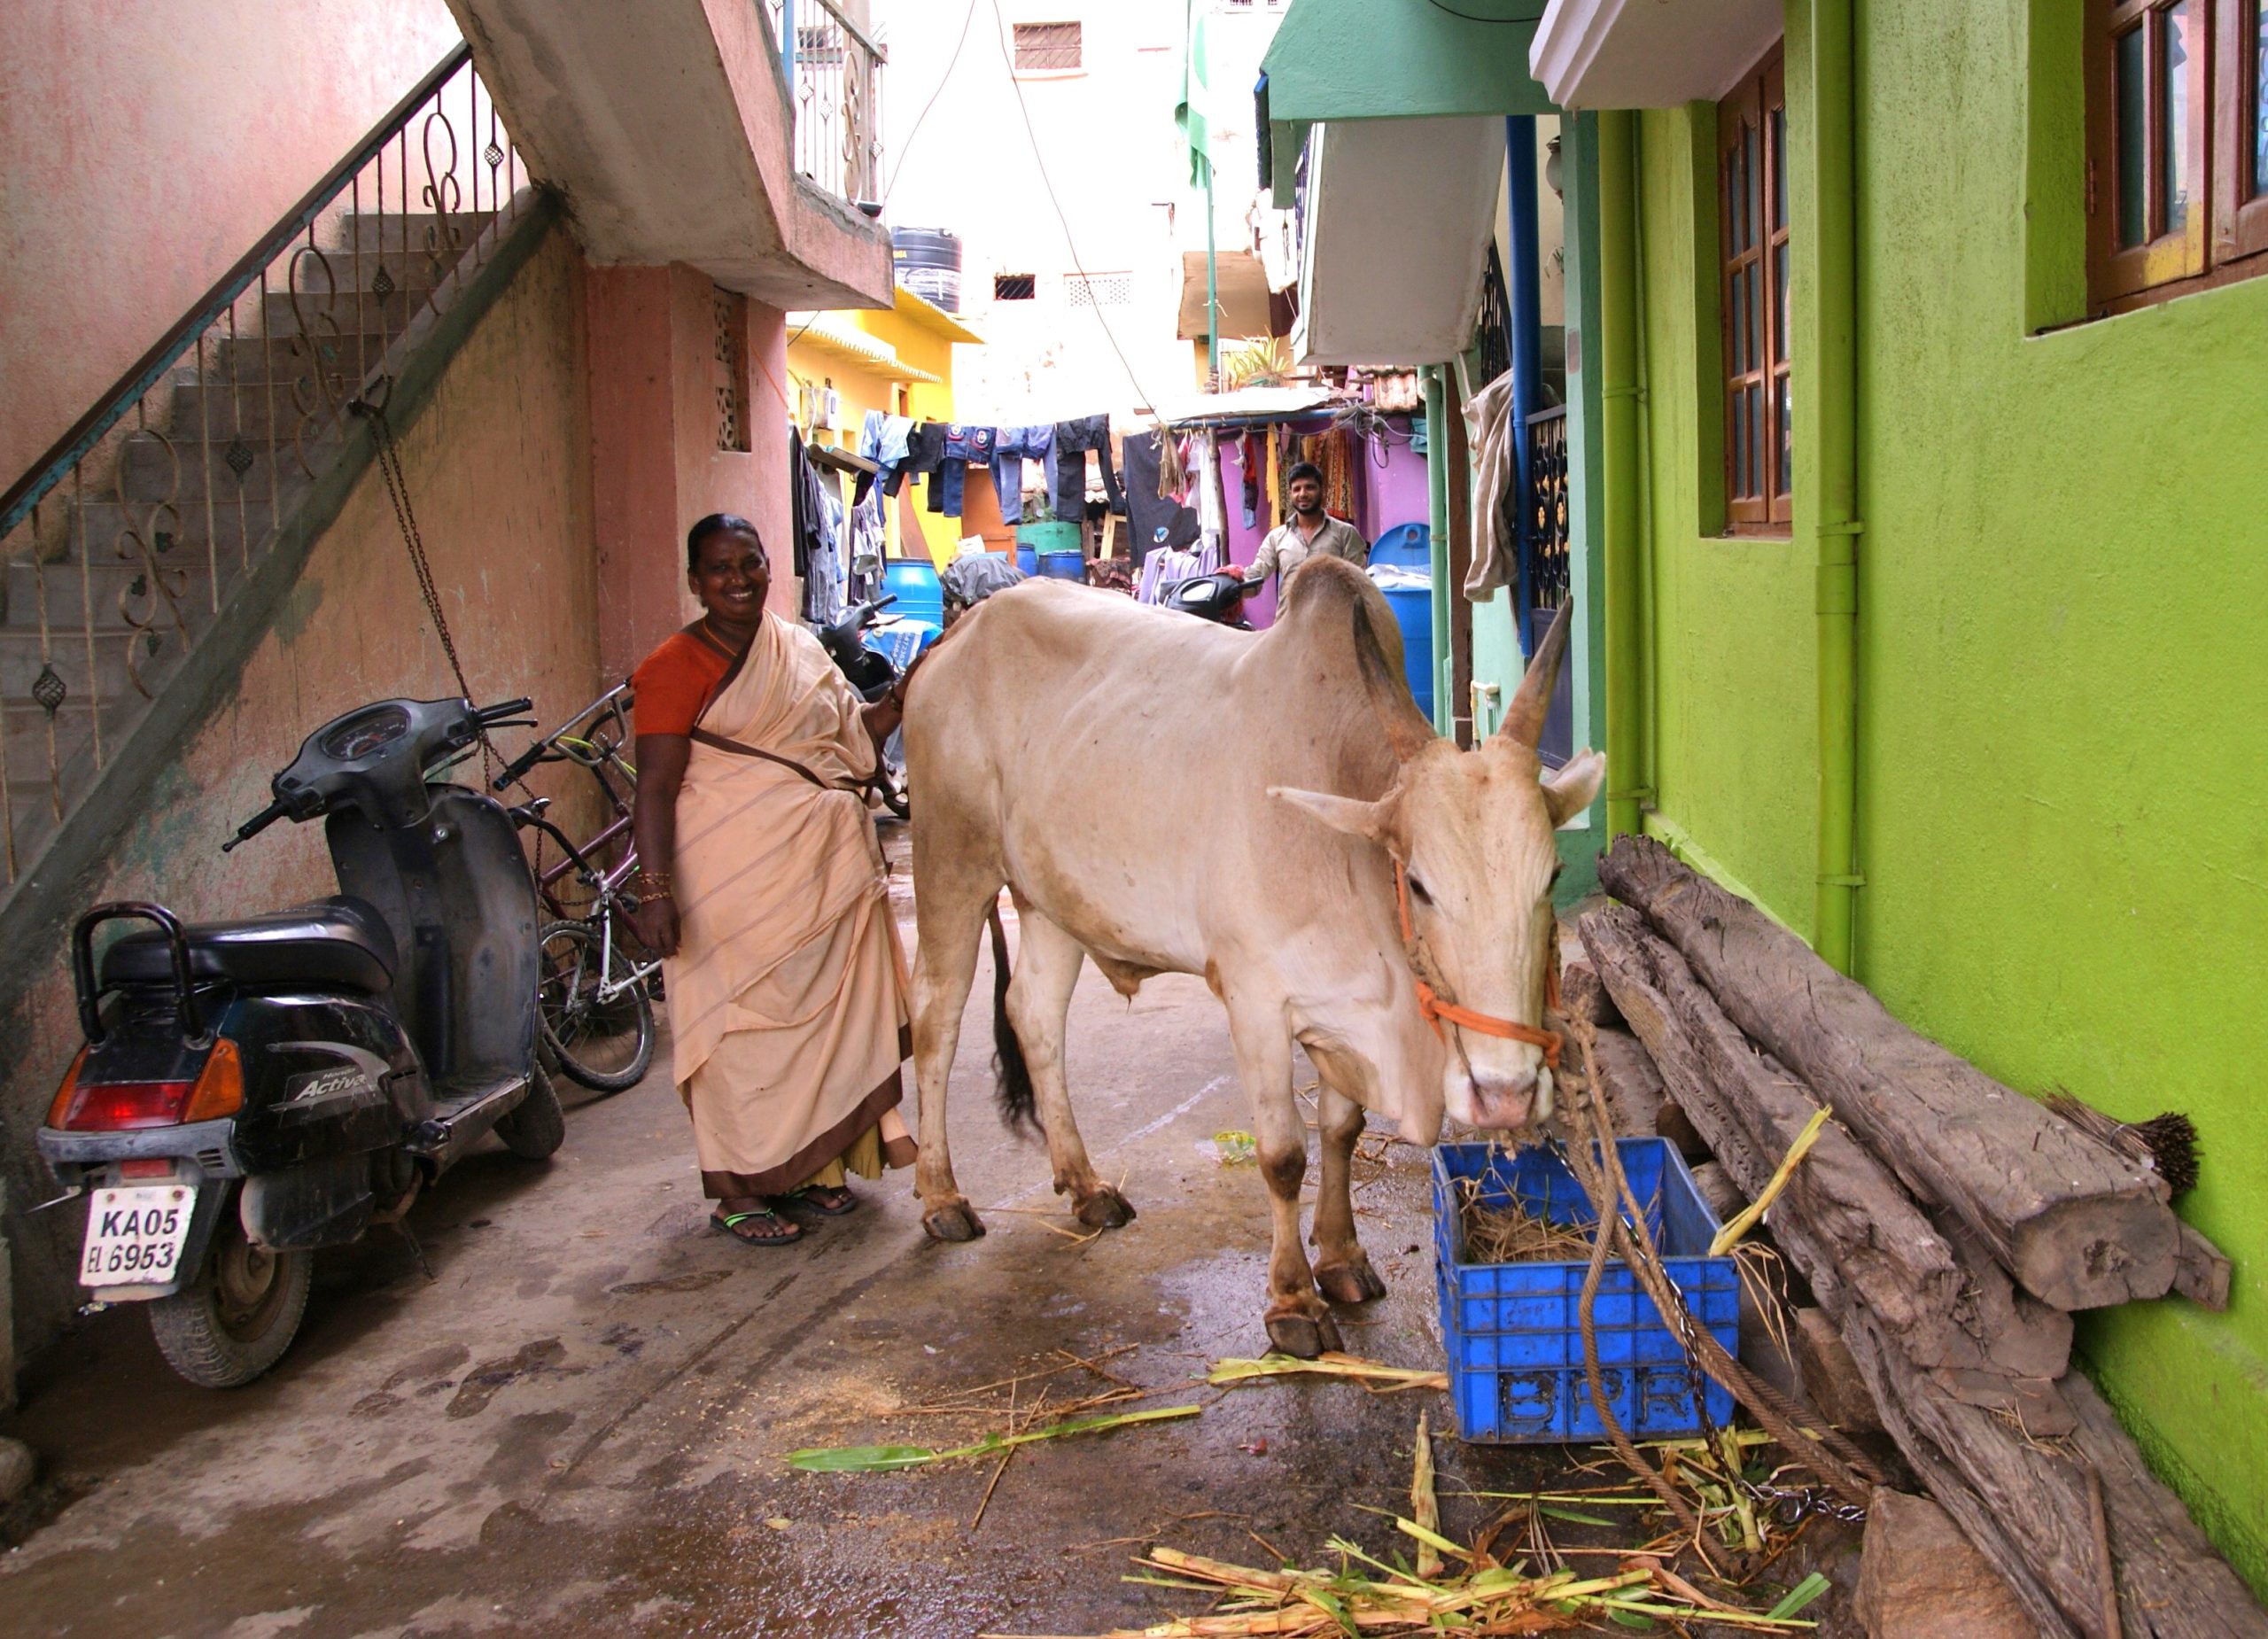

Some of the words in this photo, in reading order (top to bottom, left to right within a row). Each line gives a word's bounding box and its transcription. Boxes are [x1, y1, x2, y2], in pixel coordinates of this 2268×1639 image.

[294, 1074, 369, 1101] Activa
[100, 1208, 179, 1238] KA05
[87, 1246, 102, 1273] EL
[108, 1242, 175, 1272] 6953
